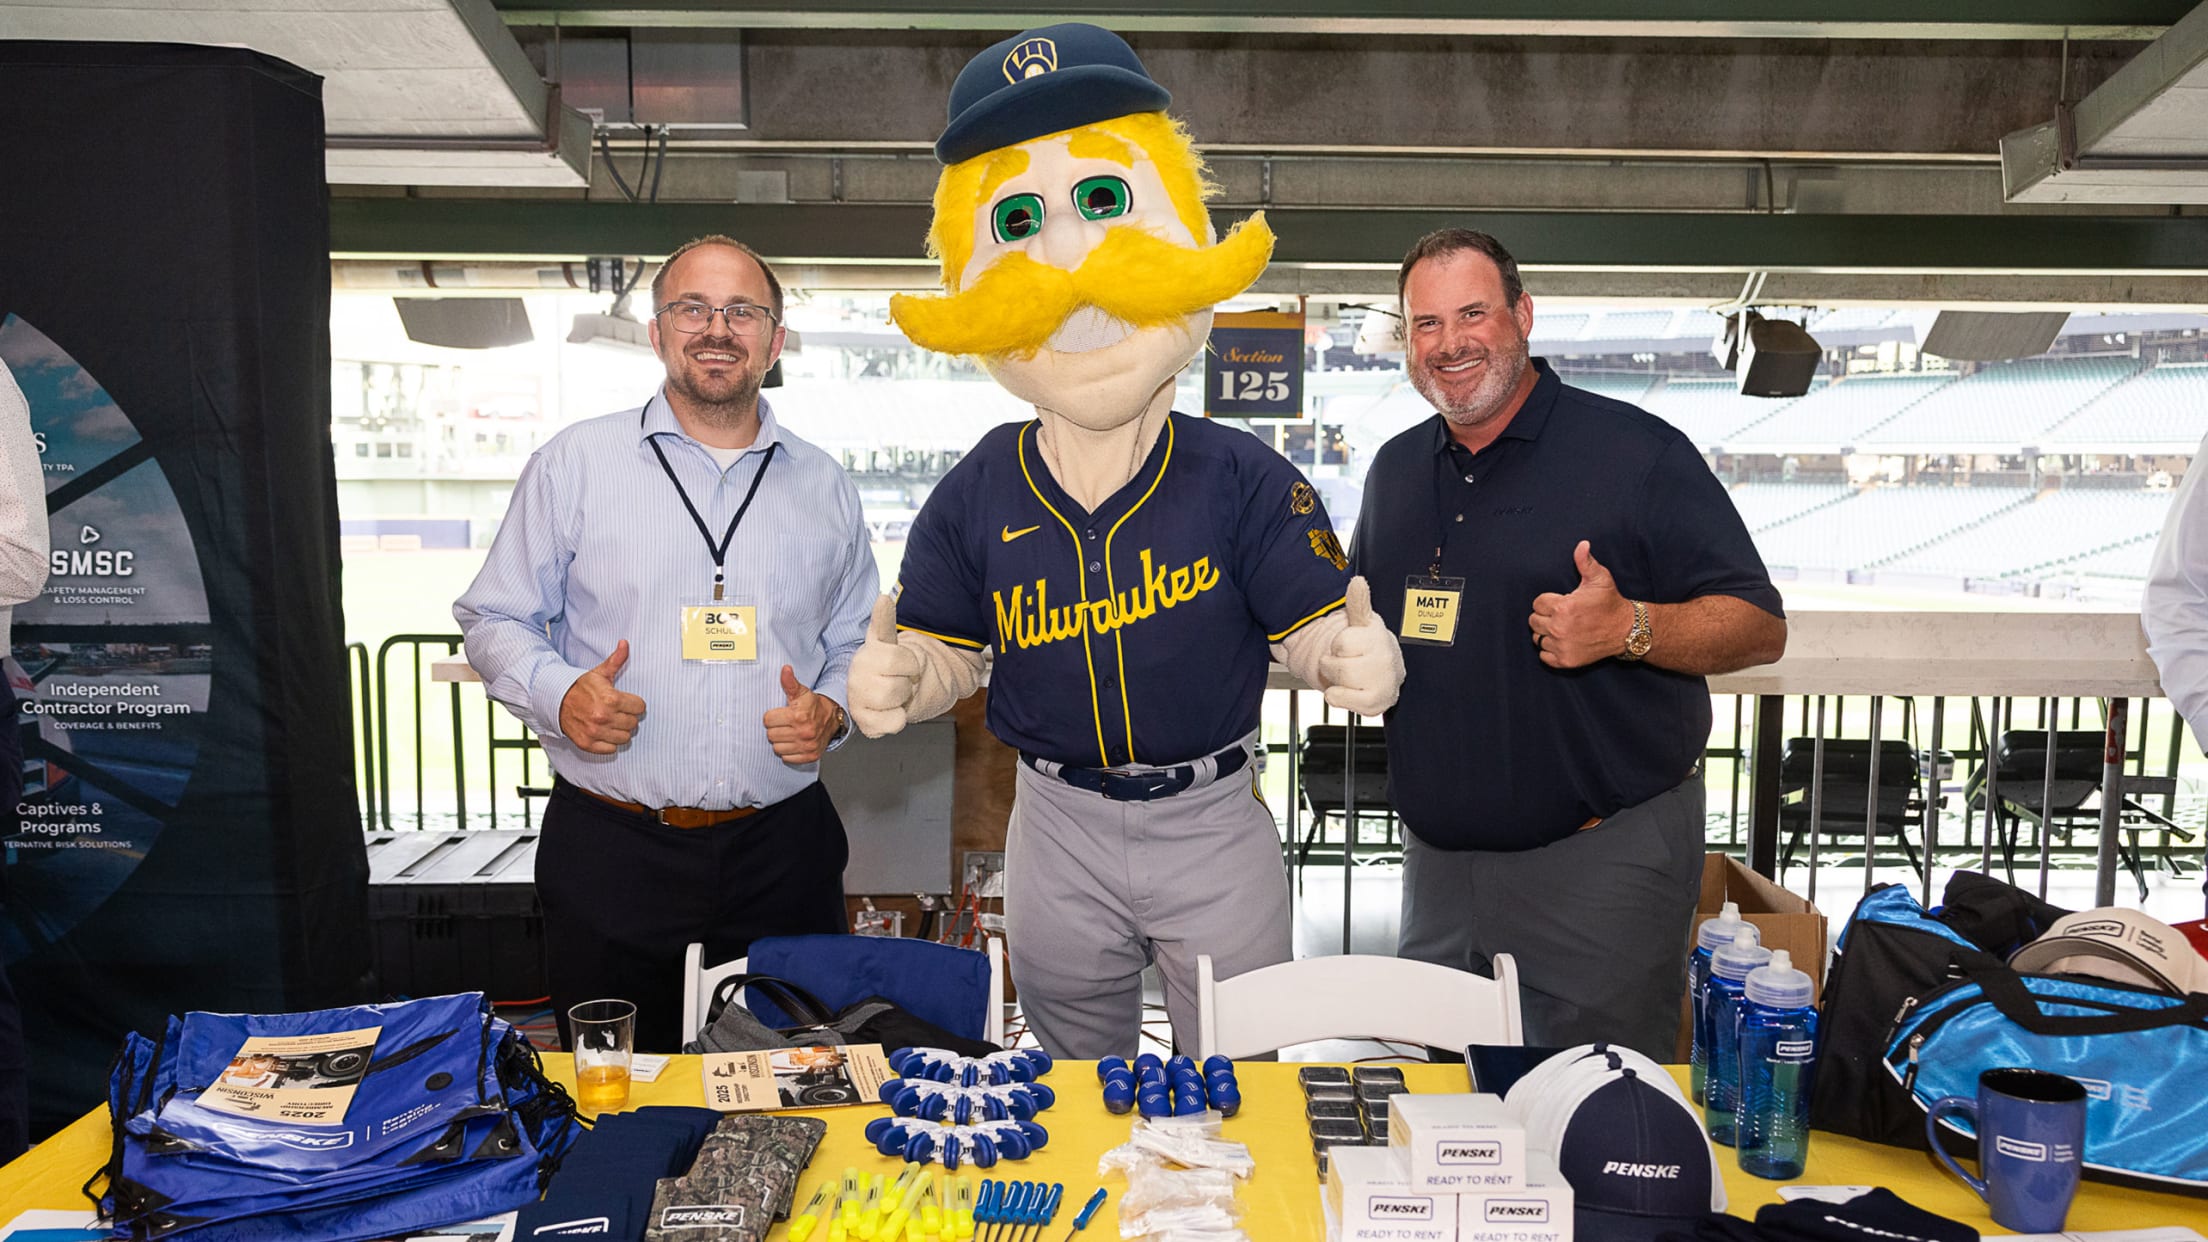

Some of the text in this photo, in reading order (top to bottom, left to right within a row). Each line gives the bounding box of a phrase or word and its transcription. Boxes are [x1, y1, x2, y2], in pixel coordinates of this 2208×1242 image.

[1223, 347, 1284, 363] Section
[1219, 371, 1290, 401] 125
[51, 550, 134, 576] SMSC
[42, 587, 145, 595] SAFETY MANAGEMENT
[993, 548, 1220, 654] Milwaukee
[1416, 596, 1449, 609] MATT
[1418, 610, 1444, 618] DUNLAP
[50, 683, 160, 698] Independent
[22, 701, 191, 717] Contractor Program
[16, 802, 103, 817] Captives &
[20, 821, 102, 836] Programs
[747, 1054, 760, 1078] WISCONSIN
[216, 1087, 275, 1100] WISCONSIN
[716, 1085, 731, 1103] 2025
[280, 1111, 327, 1119] 2025
[1442, 1149, 1497, 1158] PENSKE
[1602, 1161, 1682, 1179] PENSKE
[1427, 1176, 1513, 1186] READY TO RENT
[1373, 1204, 1429, 1214] PENSKE
[1489, 1207, 1545, 1216] PENSKE
[667, 1210, 738, 1222] PENSKE
[1357, 1229, 1443, 1239] READY TO RENT
[1473, 1232, 1560, 1242] READY TO RENT
